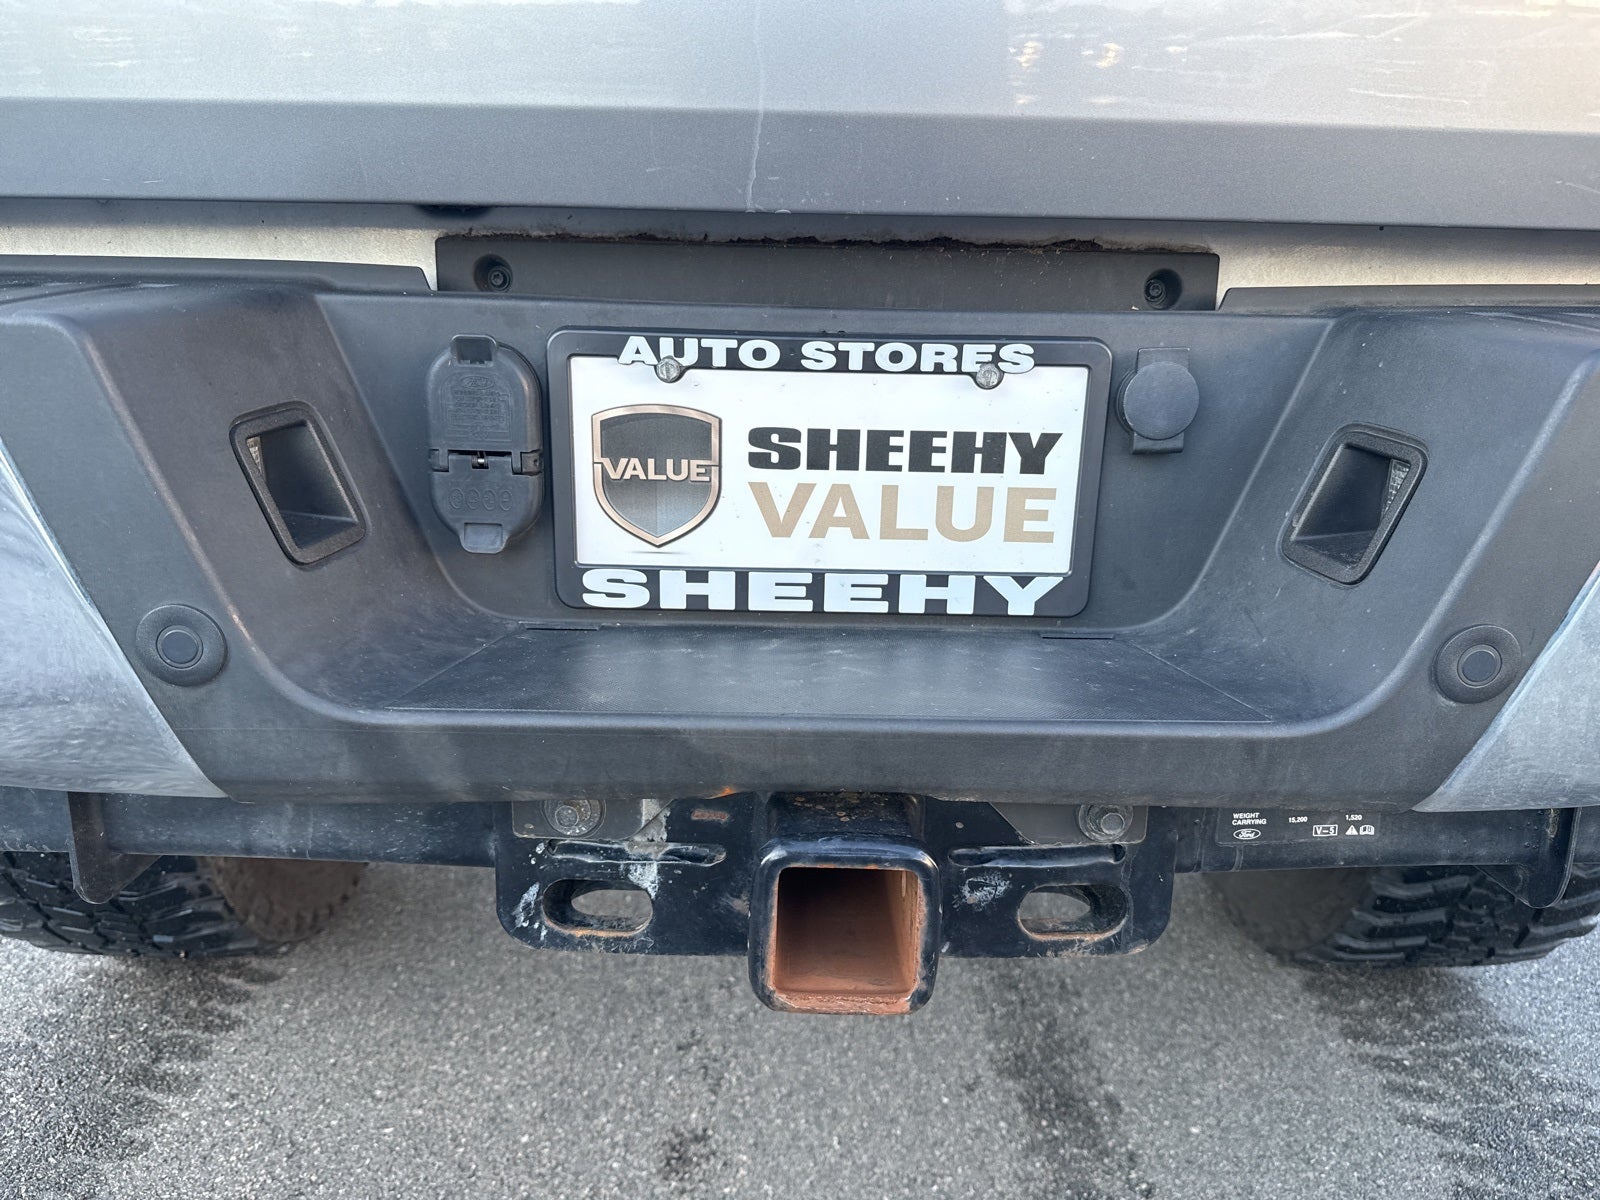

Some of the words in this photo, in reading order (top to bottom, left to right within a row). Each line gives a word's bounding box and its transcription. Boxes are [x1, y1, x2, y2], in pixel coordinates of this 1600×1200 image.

[618, 336, 781, 370] AUTO
[801, 341, 1035, 374] STORES
[601, 457, 710, 482] VALUE
[747, 427, 1063, 475] SHEEHY
[748, 482, 1057, 543] VALUE
[582, 569, 1064, 616] SHEEHY
[1235, 829, 1258, 839] Ford
